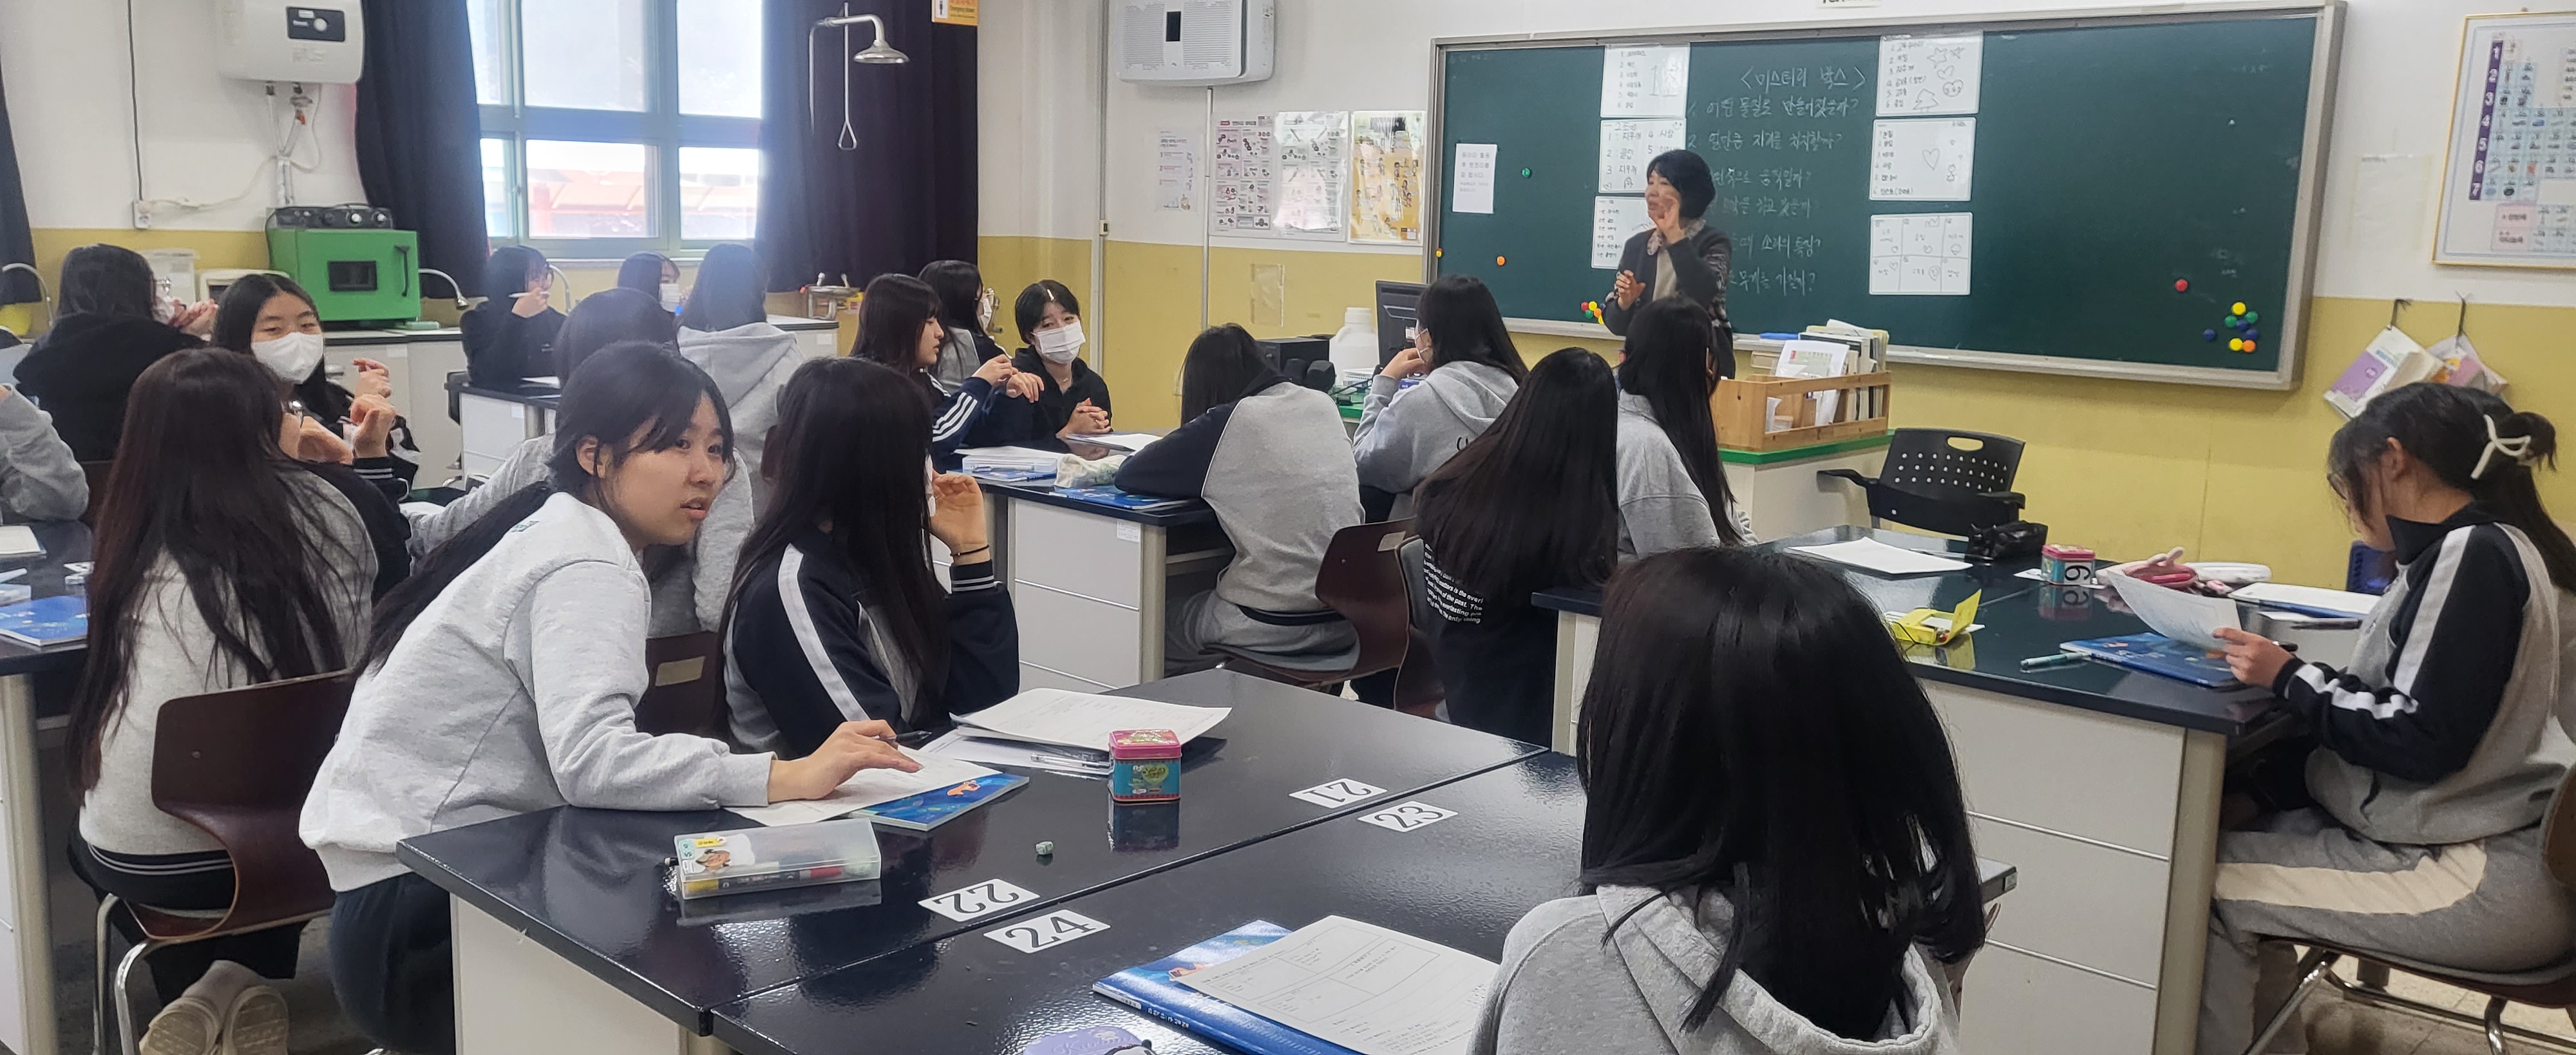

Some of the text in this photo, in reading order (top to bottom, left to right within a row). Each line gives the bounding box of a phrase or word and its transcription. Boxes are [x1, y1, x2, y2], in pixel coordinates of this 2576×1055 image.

[2493, 46, 2499, 59] 1
[2489, 68, 2497, 82] 2
[2485, 92, 2494, 106] 3
[2481, 114, 2490, 126] 4
[1622, 131, 1642, 140] 지우개
[1648, 129, 1654, 138] 4
[2477, 137, 2488, 151] 5
[1606, 149, 1611, 158] 2
[1648, 145, 1653, 154] 5
[1606, 164, 1637, 175] 3 지우개
[2475, 160, 2484, 173] 6
[2472, 183, 2481, 196] 7
[1302, 781, 1372, 803] 21
[1374, 806, 1444, 829] 23
[932, 883, 1019, 914] 22
[1005, 916, 1096, 948] 24
